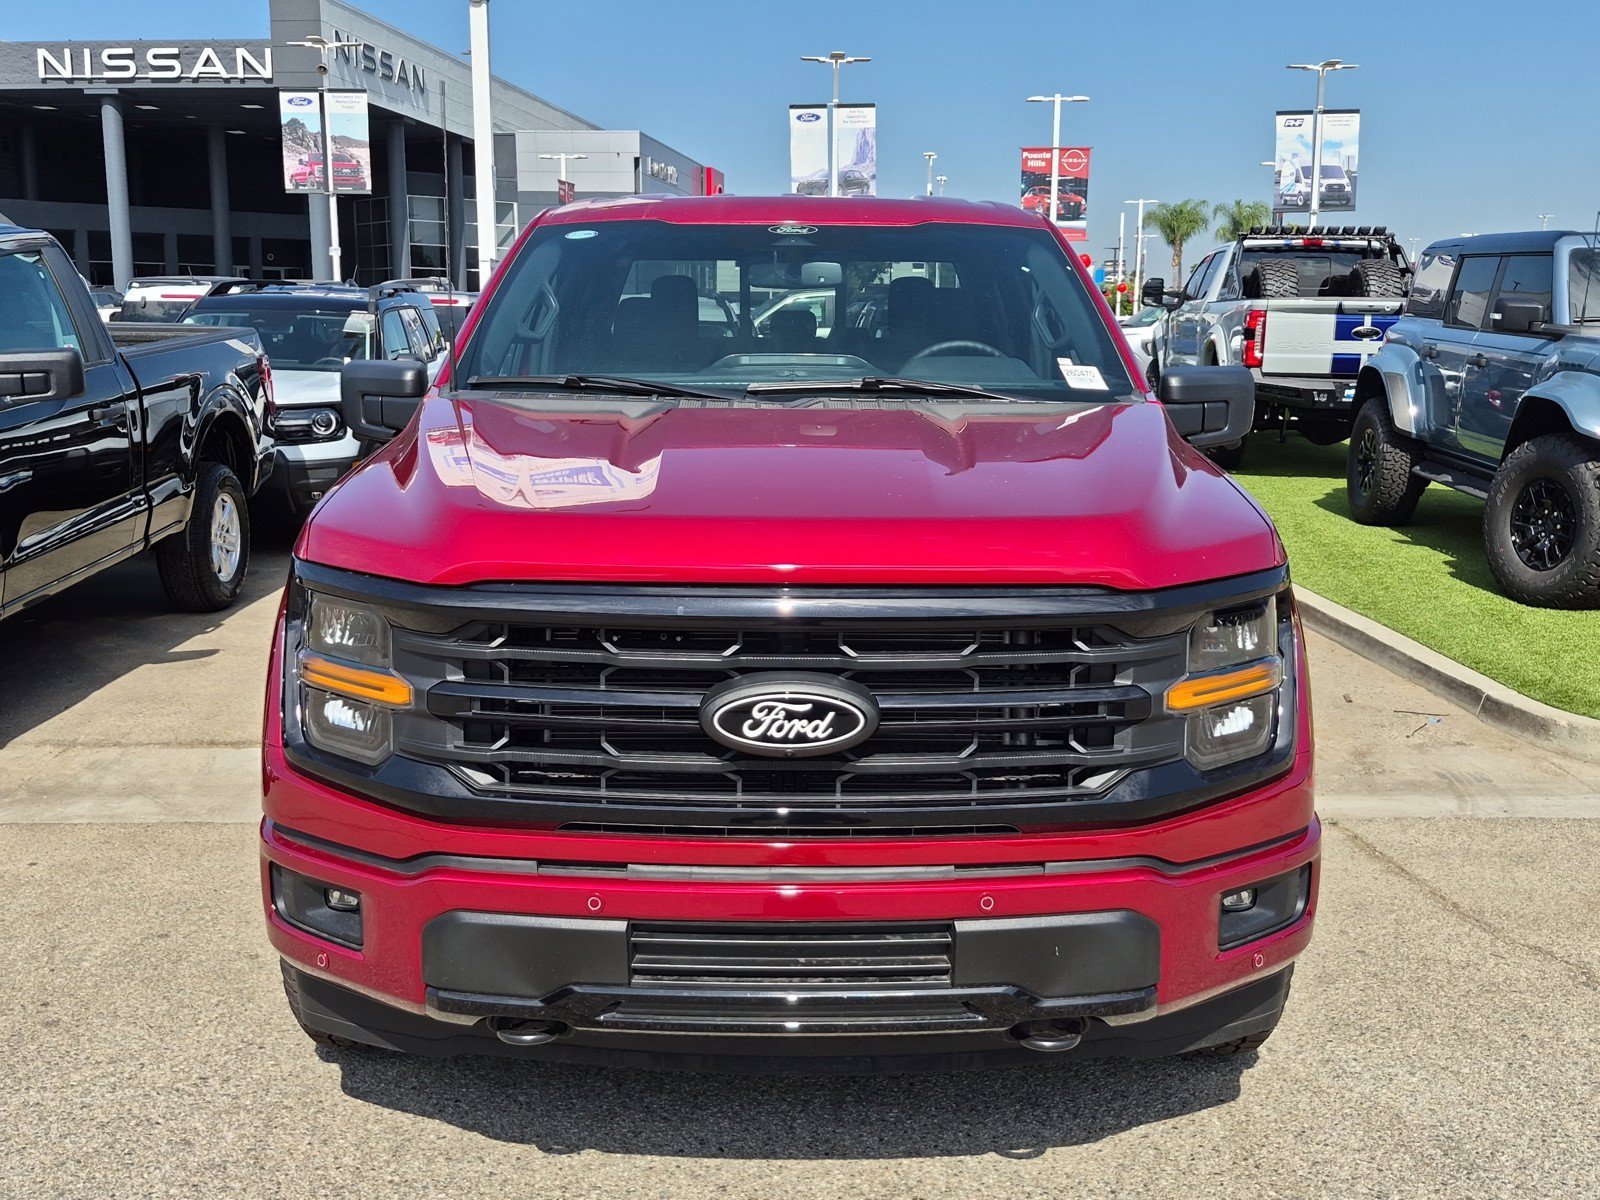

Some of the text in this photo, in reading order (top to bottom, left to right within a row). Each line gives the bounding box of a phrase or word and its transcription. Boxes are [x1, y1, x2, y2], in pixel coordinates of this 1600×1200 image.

[36, 47, 273, 79] NISSAN
[333, 29, 425, 95] NISSAN
[1022, 151, 1052, 159] Puente
[776, 225, 810, 234] Ford
[742, 701, 837, 740] Ford
